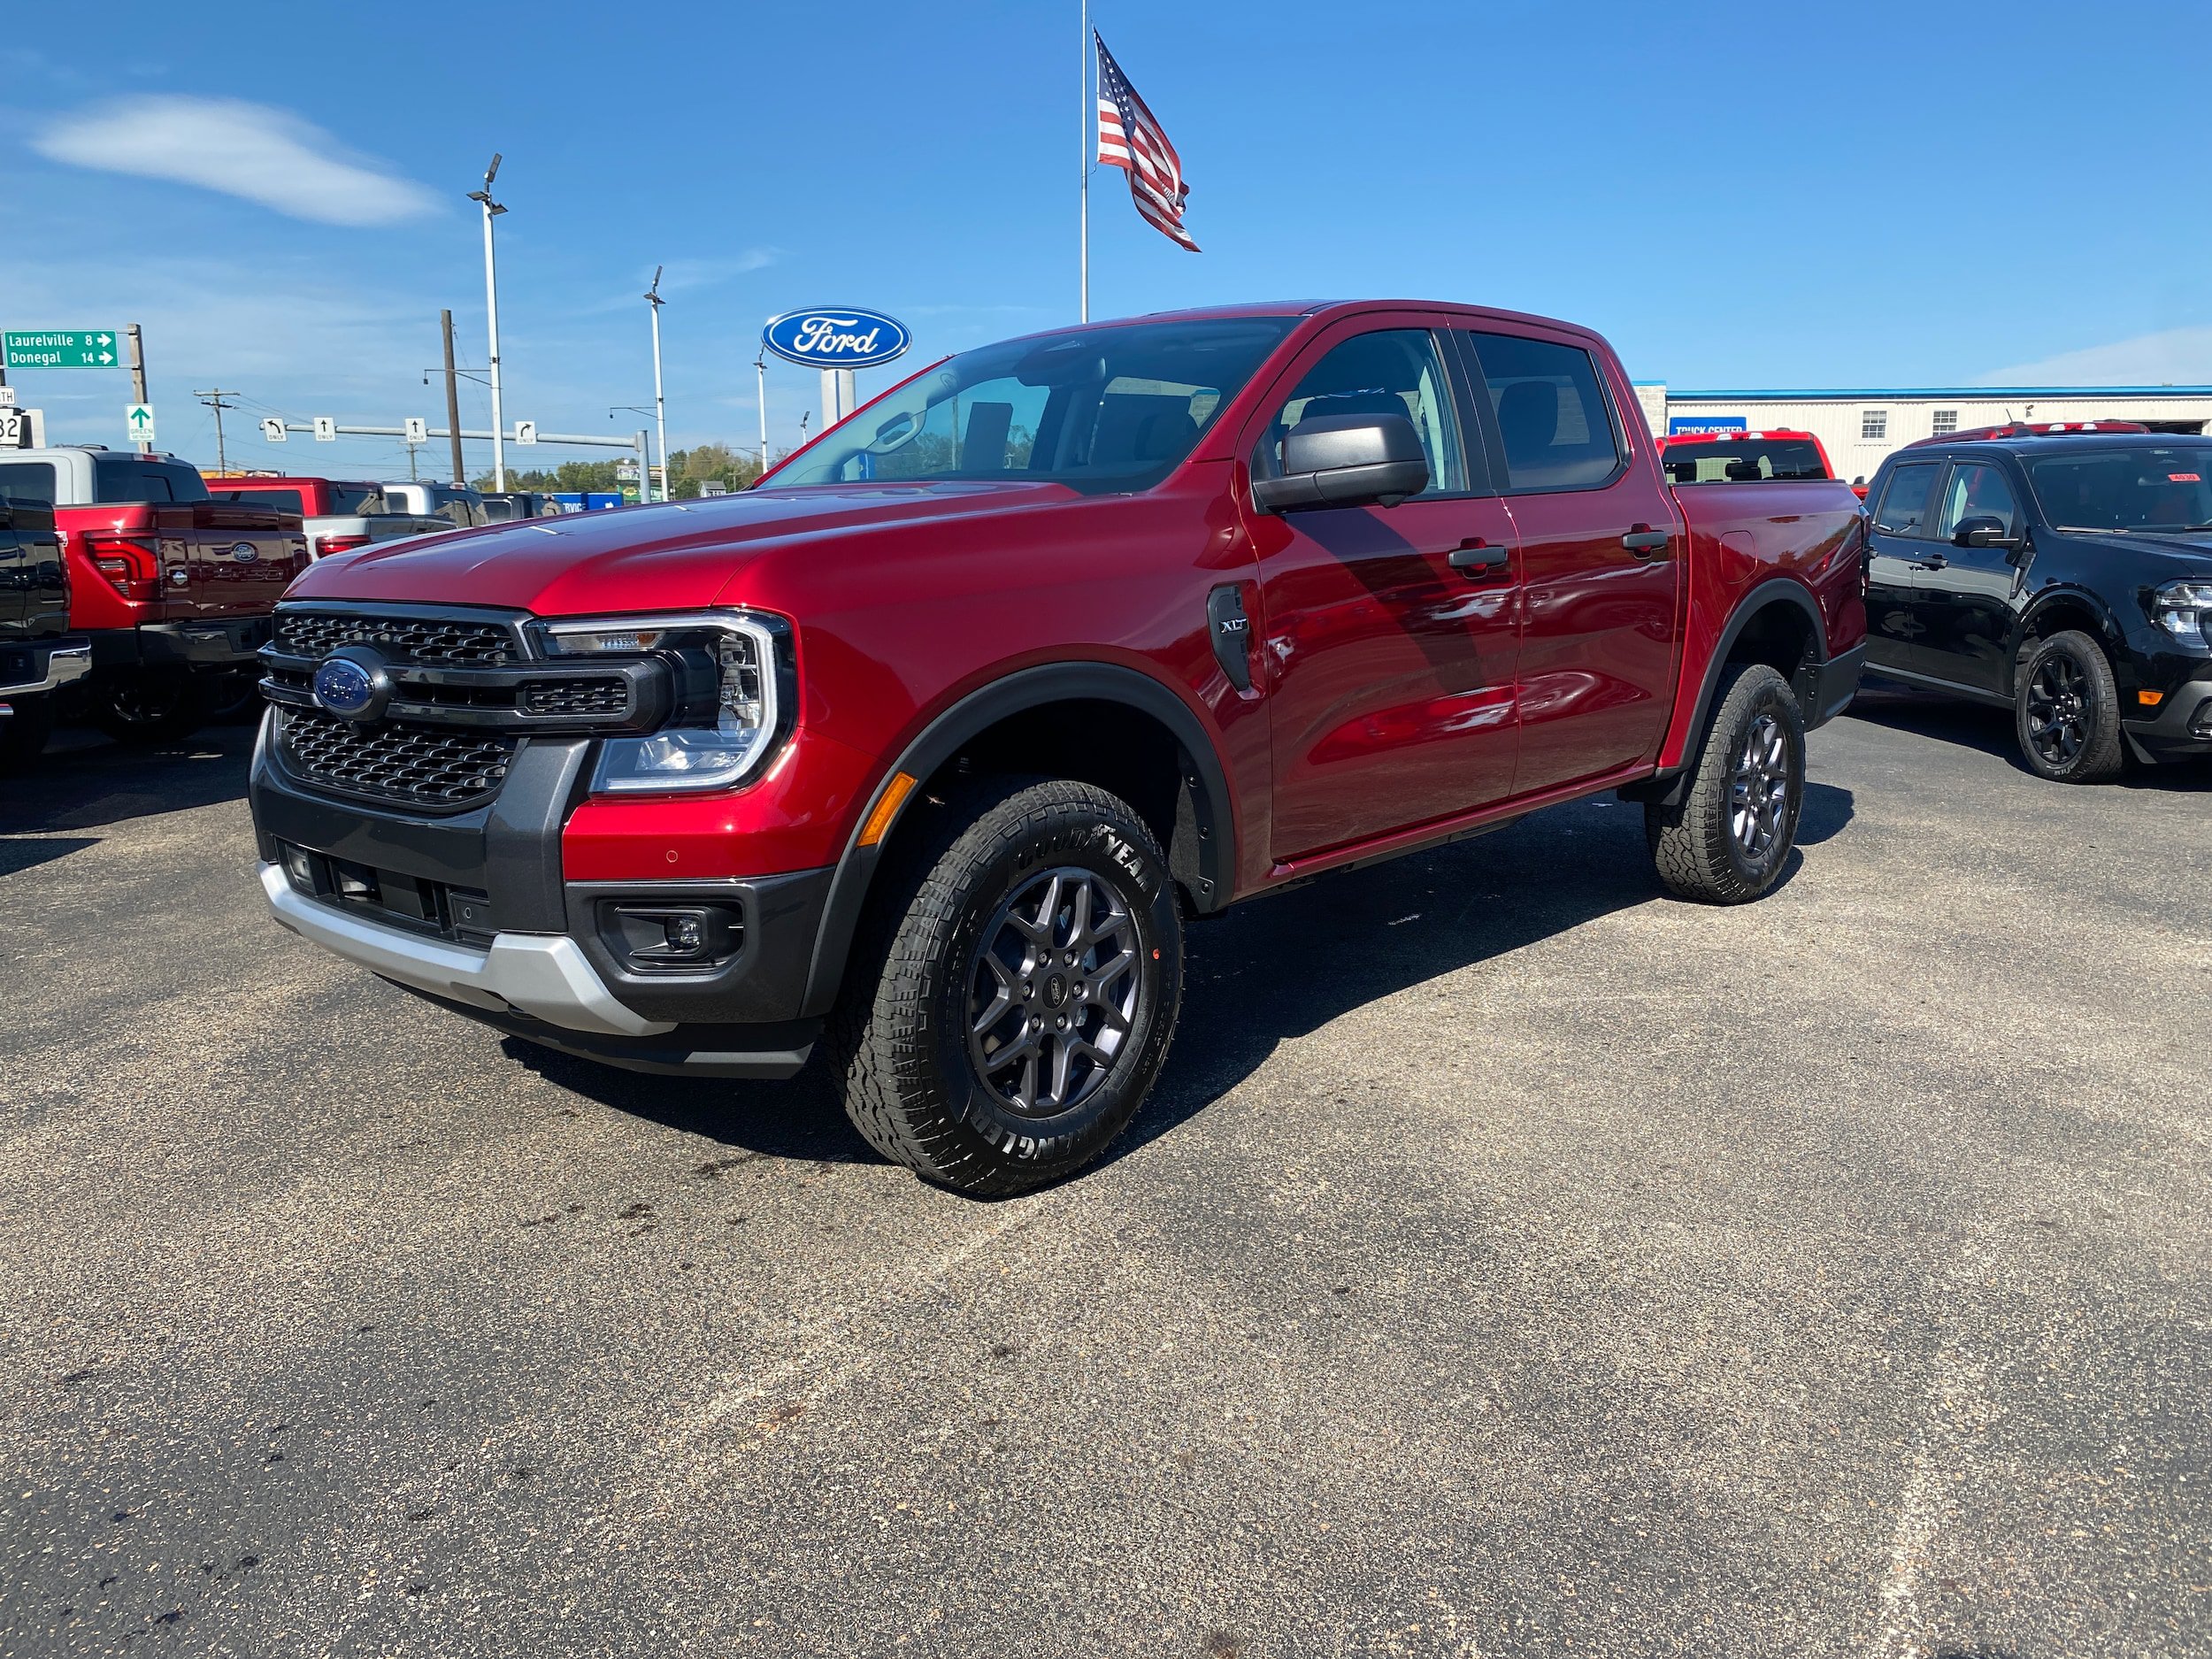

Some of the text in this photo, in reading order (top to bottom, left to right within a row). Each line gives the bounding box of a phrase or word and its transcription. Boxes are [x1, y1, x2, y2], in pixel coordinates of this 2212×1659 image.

[9, 334, 93, 347] Laurelville 8
[793, 317, 880, 354] Ford
[11, 351, 94, 365] Donegal 14
[0, 391, 13, 403] TH
[563, 503, 587, 513] RVICE
[1220, 618, 1248, 634] XLT
